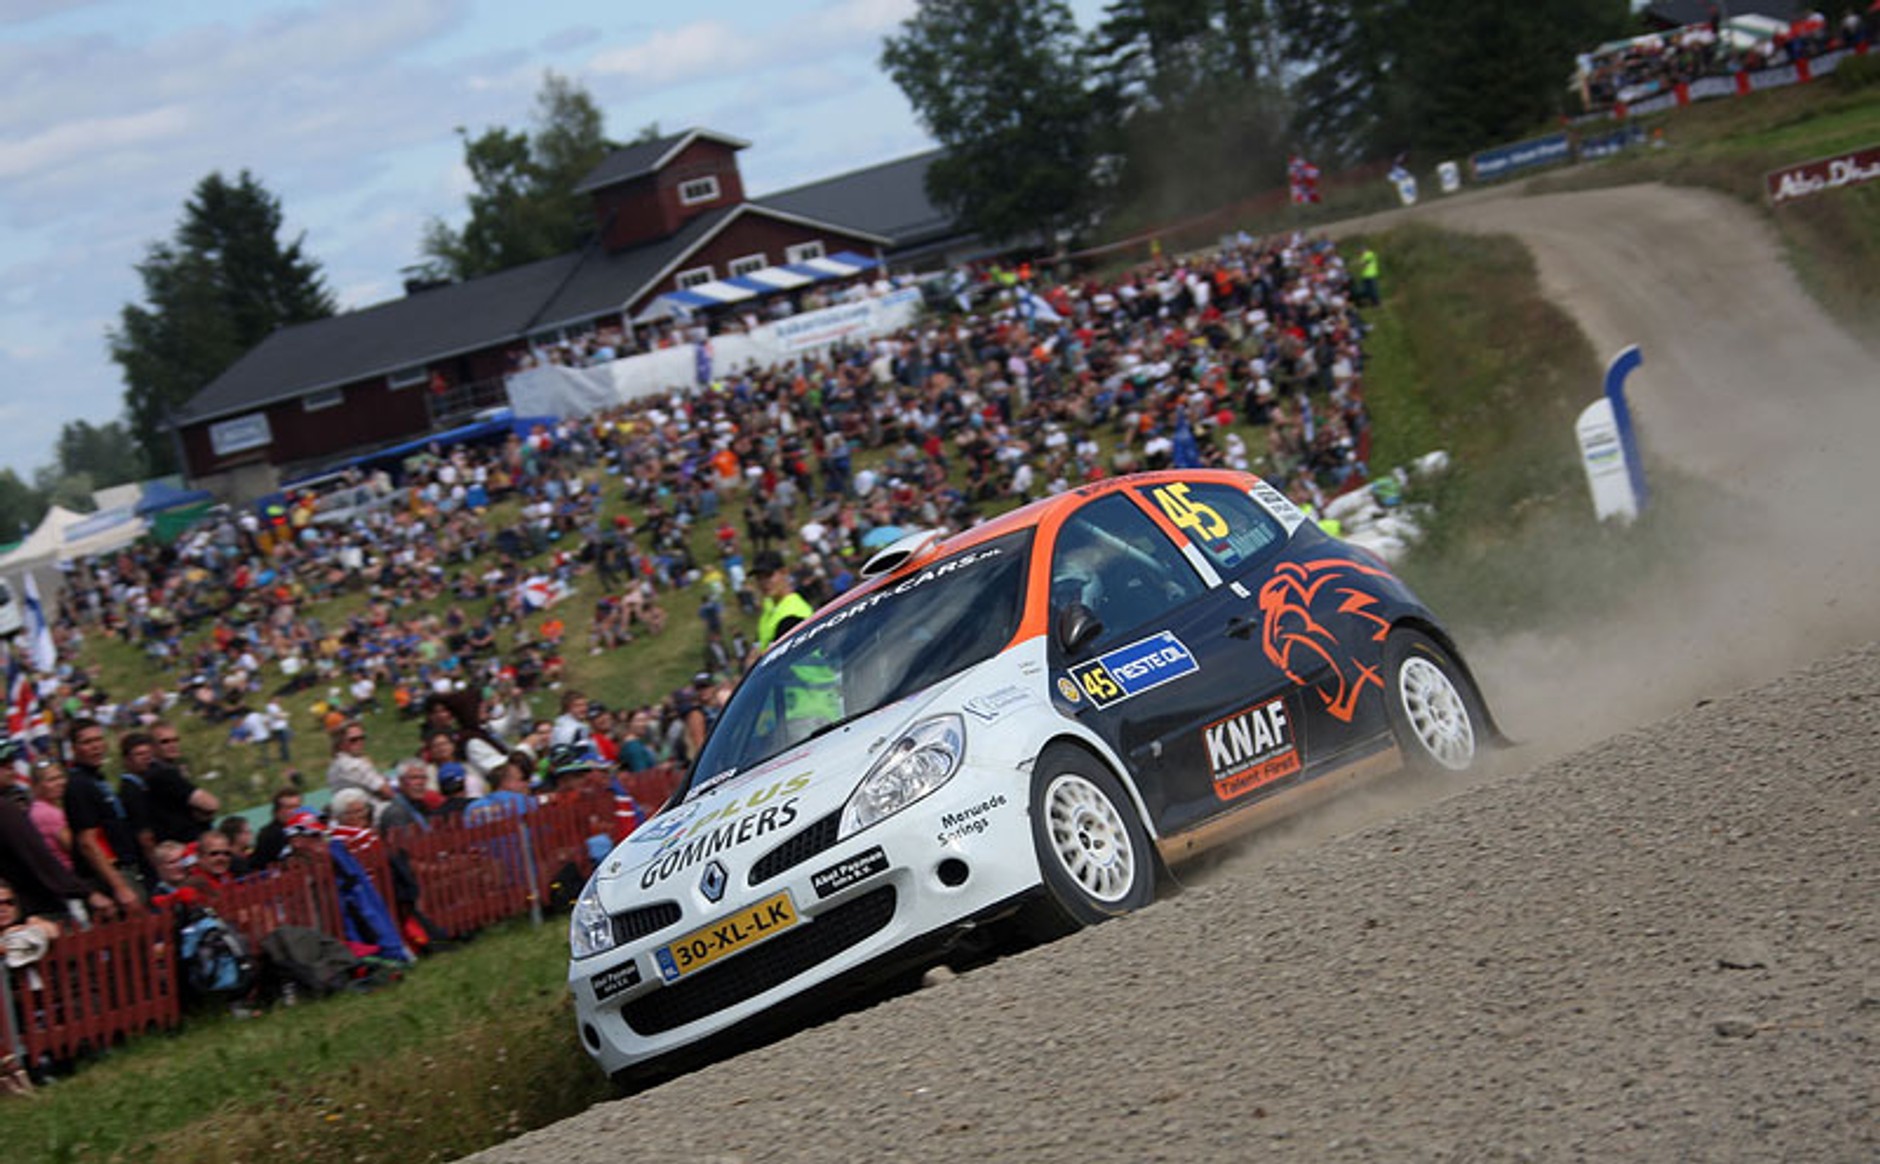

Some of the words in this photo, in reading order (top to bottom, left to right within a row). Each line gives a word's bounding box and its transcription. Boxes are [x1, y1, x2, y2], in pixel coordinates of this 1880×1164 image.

[1153, 482, 1229, 541] 45
[1083, 667, 1118, 699] 45
[1112, 652, 1166, 683] NESTE
[1205, 700, 1287, 771] KNAF
[686, 771, 814, 837] PLUS
[641, 797, 799, 890] GOMMERS
[677, 900, 790, 967] 30-XL-LK
